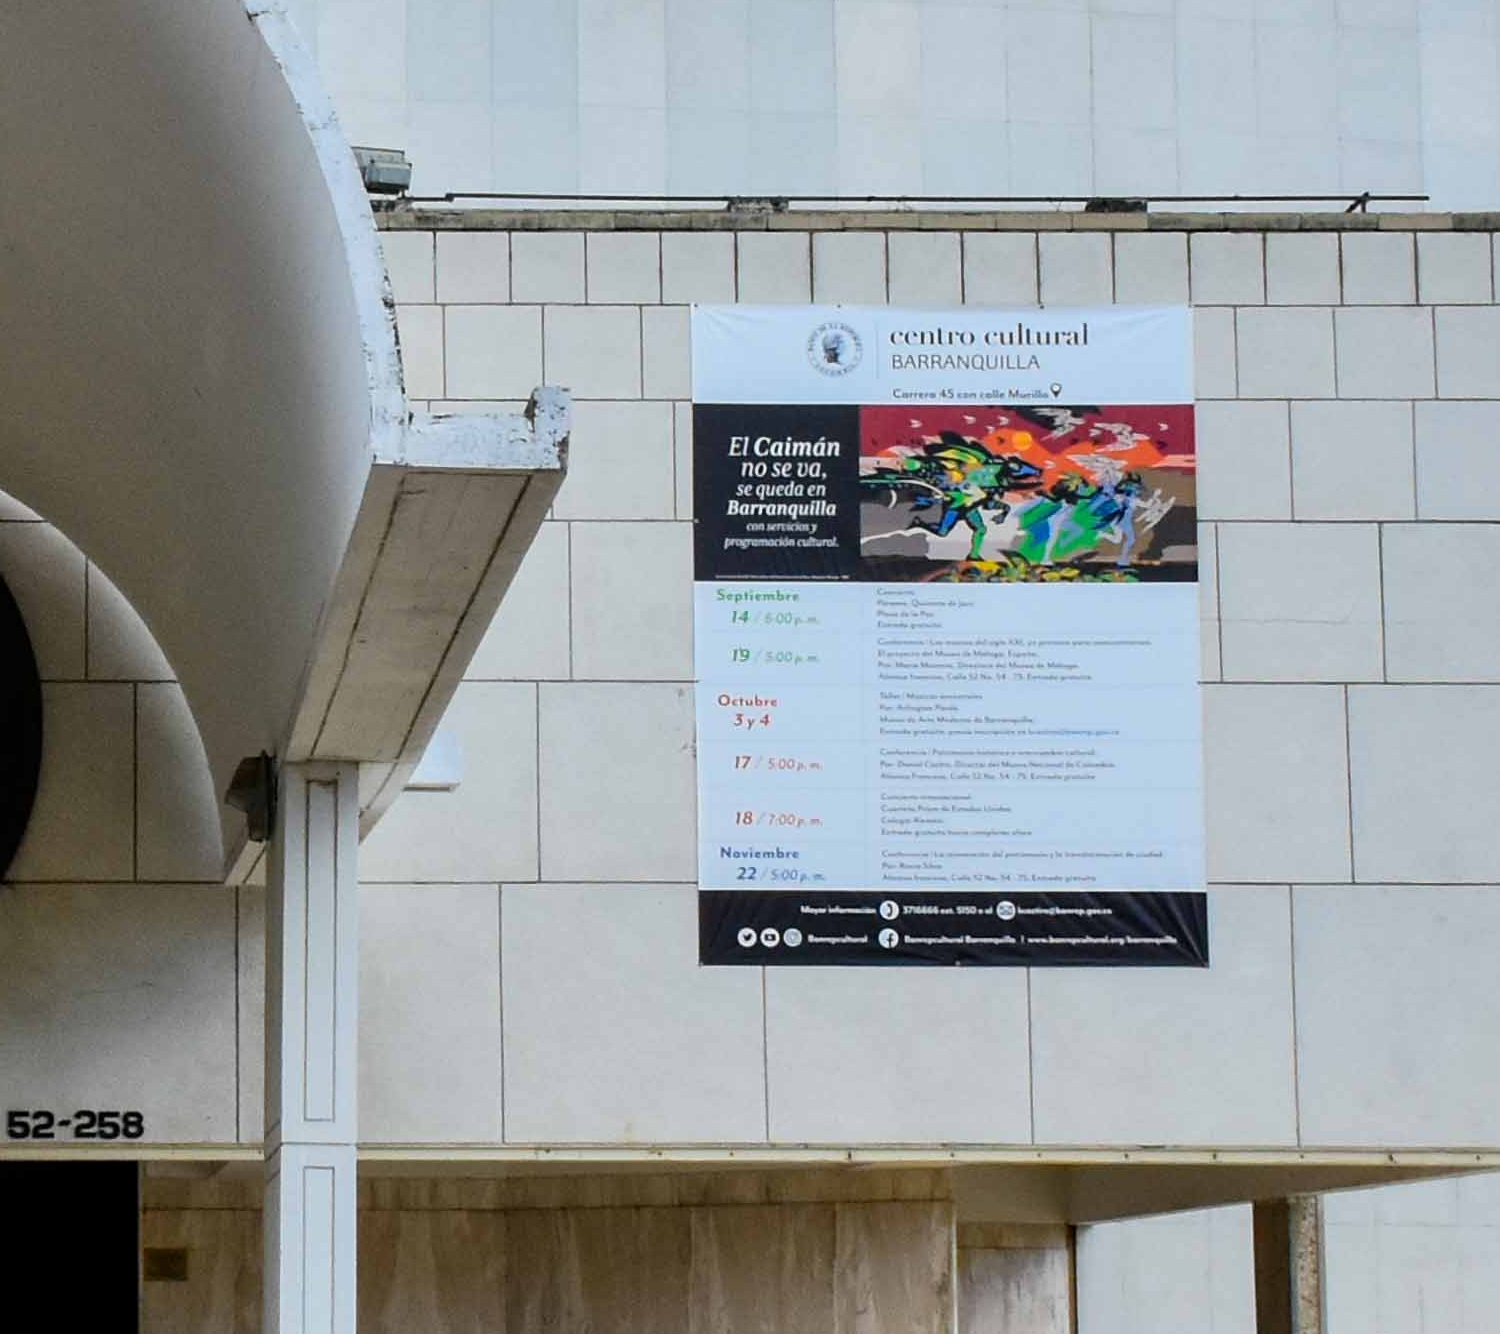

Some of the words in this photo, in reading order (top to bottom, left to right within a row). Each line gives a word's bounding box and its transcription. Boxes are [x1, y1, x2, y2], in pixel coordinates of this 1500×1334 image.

[890, 327, 975, 346] centro
[985, 323, 1088, 346] cultural
[892, 354, 1041, 371] BARRANQUILLA
[893, 388, 936, 399] Carrera
[939, 388, 954, 399] 45
[957, 391, 976, 399] con
[980, 388, 1005, 399] calle
[1008, 388, 1049, 399] Murillo
[728, 436, 748, 457] El
[753, 436, 840, 457] Caimán
[741, 462, 767, 478] no
[771, 462, 792, 478] se
[797, 462, 827, 480] va,
[736, 484, 752, 497] se
[756, 481, 804, 501] queda
[807, 484, 826, 497] en
[726, 499, 837, 520] Barranquilla
[746, 523, 764, 532] con
[766, 522, 809, 532] servicios
[809, 523, 818, 534] y
[723, 536, 795, 550] programación
[797, 536, 839, 548] cultural.
[717, 588, 799, 603] Septiembre
[731, 611, 749, 623] 14
[732, 648, 750, 662] 19
[718, 694, 777, 707] Octubre
[734, 713, 743, 726] 3
[747, 719, 755, 730] y
[760, 713, 770, 726] 4
[735, 756, 751, 769] 17
[735, 811, 752, 825] 18
[720, 847, 800, 859] Noviembre
[736, 867, 756, 880] 22
[8, 1110, 144, 1139] 52-258
